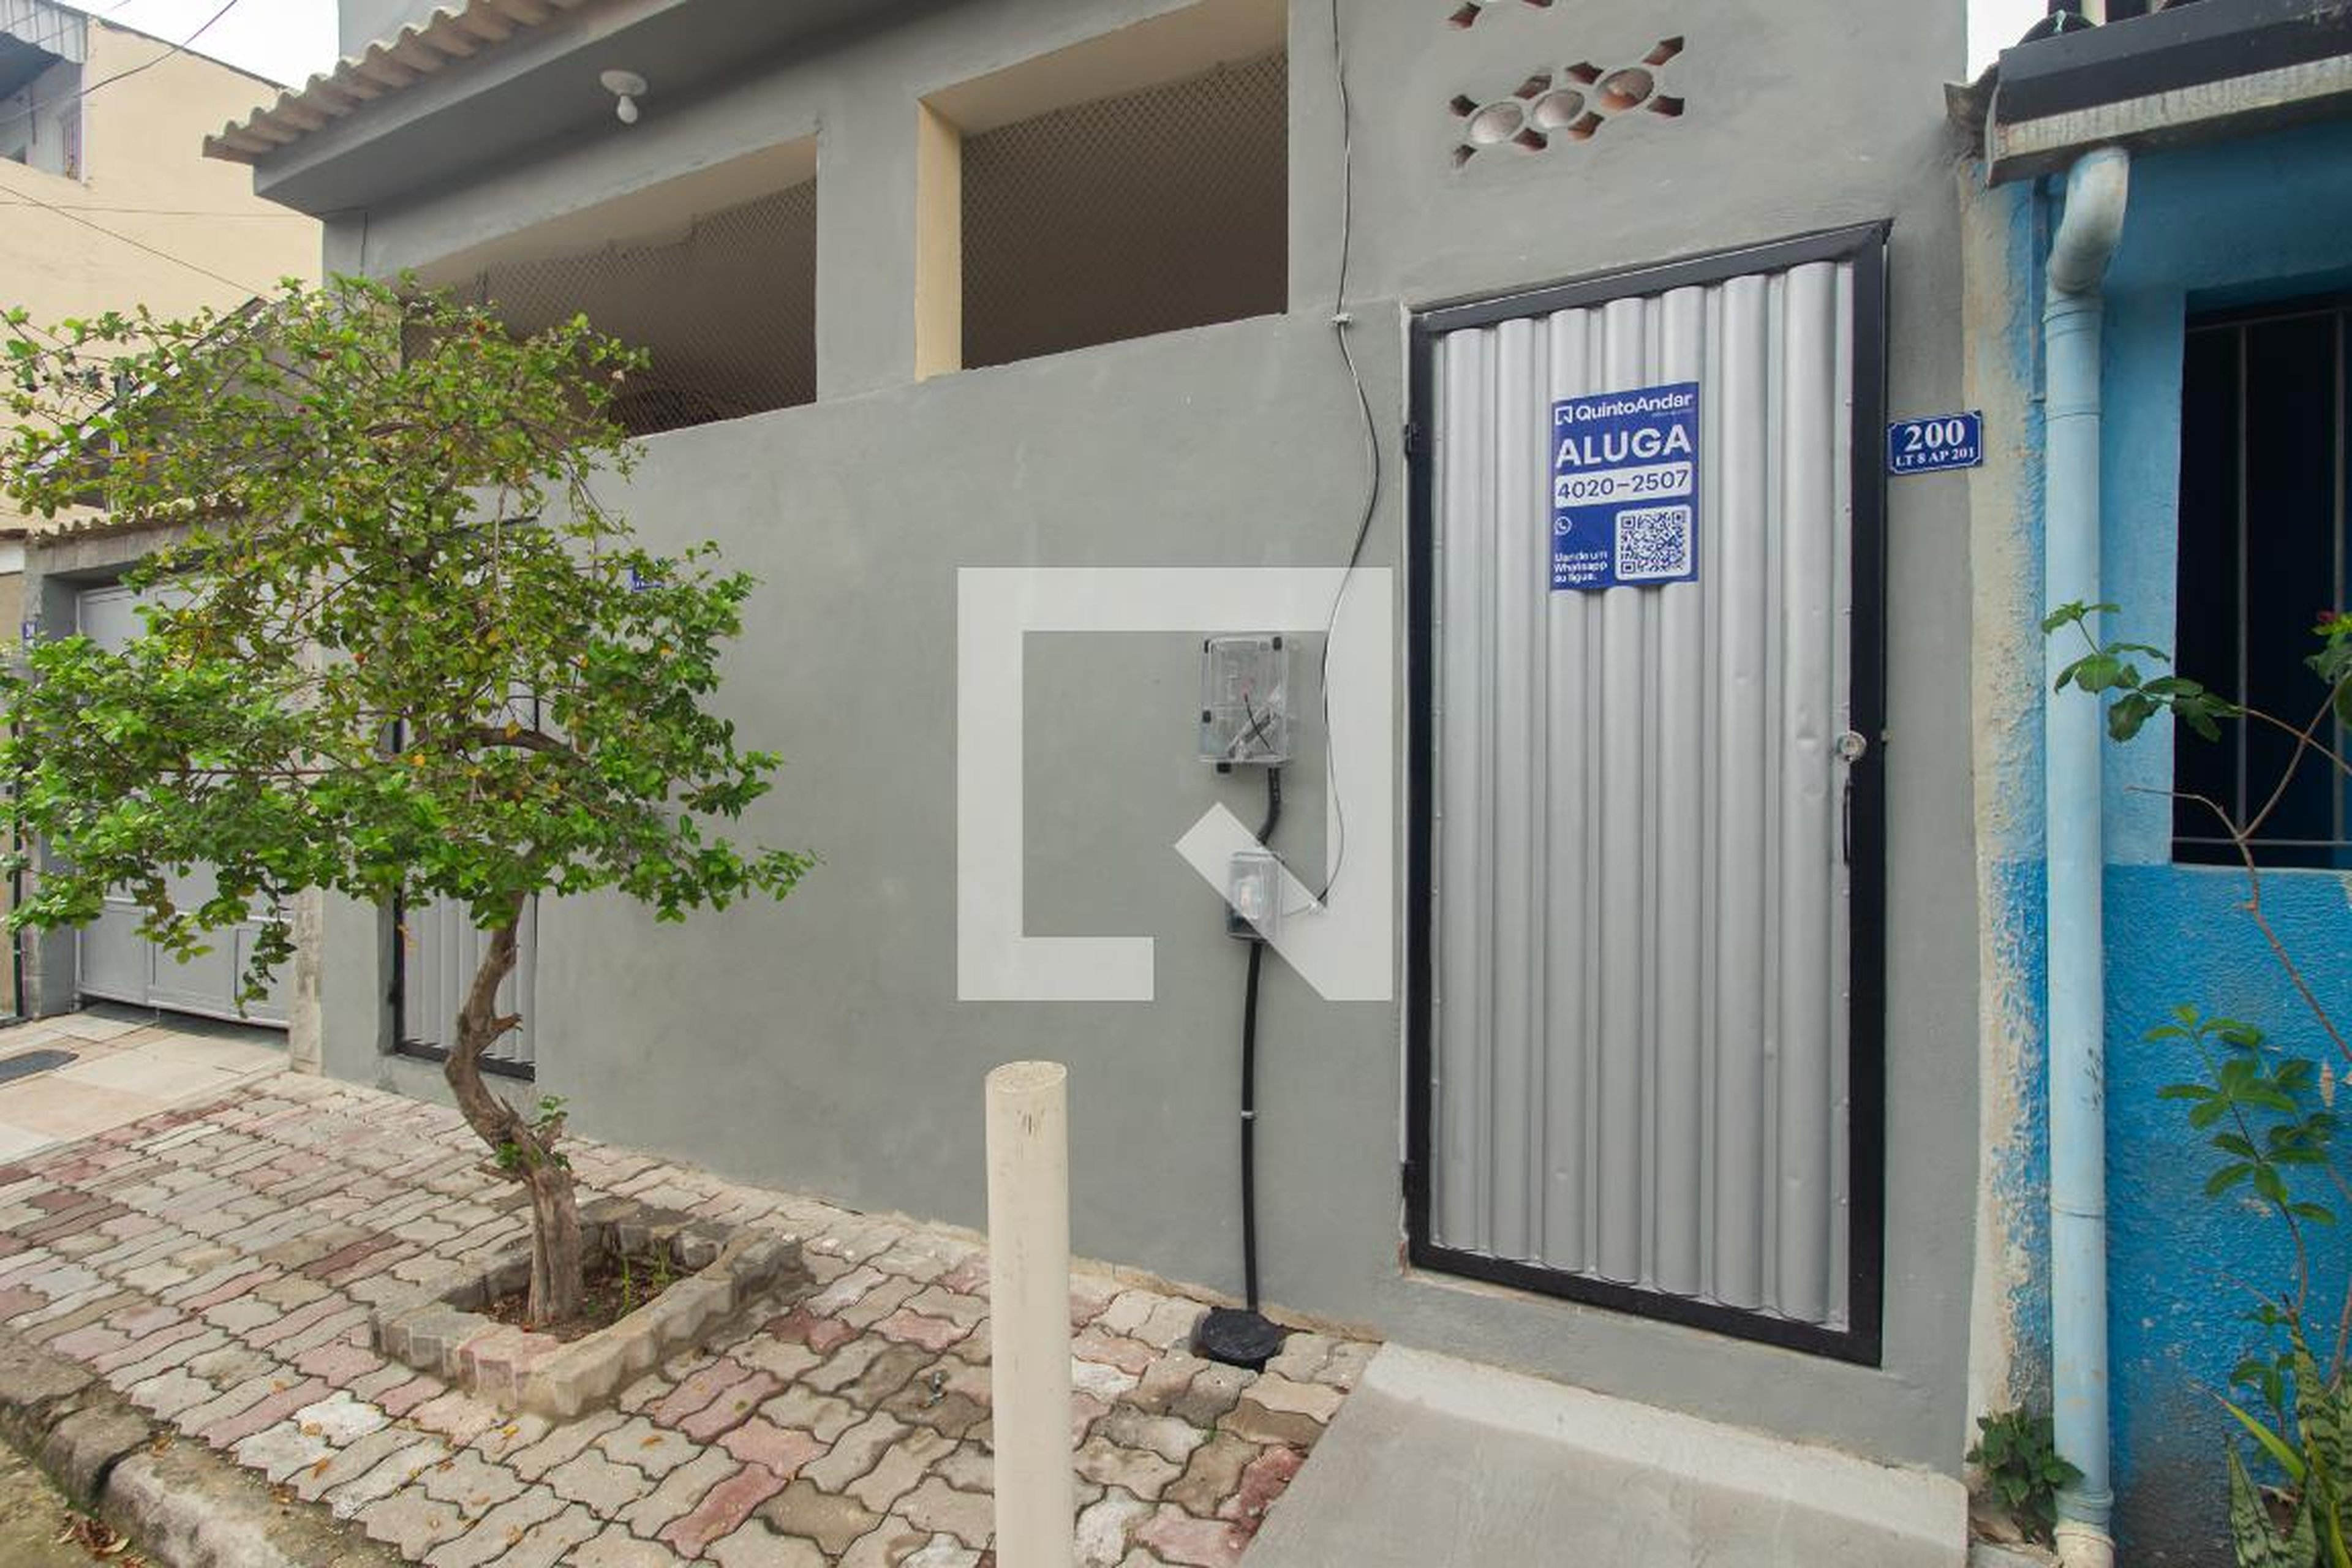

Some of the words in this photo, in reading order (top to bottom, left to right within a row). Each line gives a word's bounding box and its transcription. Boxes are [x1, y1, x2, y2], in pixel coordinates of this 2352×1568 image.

[1575, 393, 1693, 420] QuintoAndar
[1556, 424, 1691, 468] ALUGA
[1904, 420, 1965, 452] 200
[1928, 450, 1949, 462] AP
[1951, 447, 1974, 459] 201
[1558, 470, 1689, 499] 4020-2507
